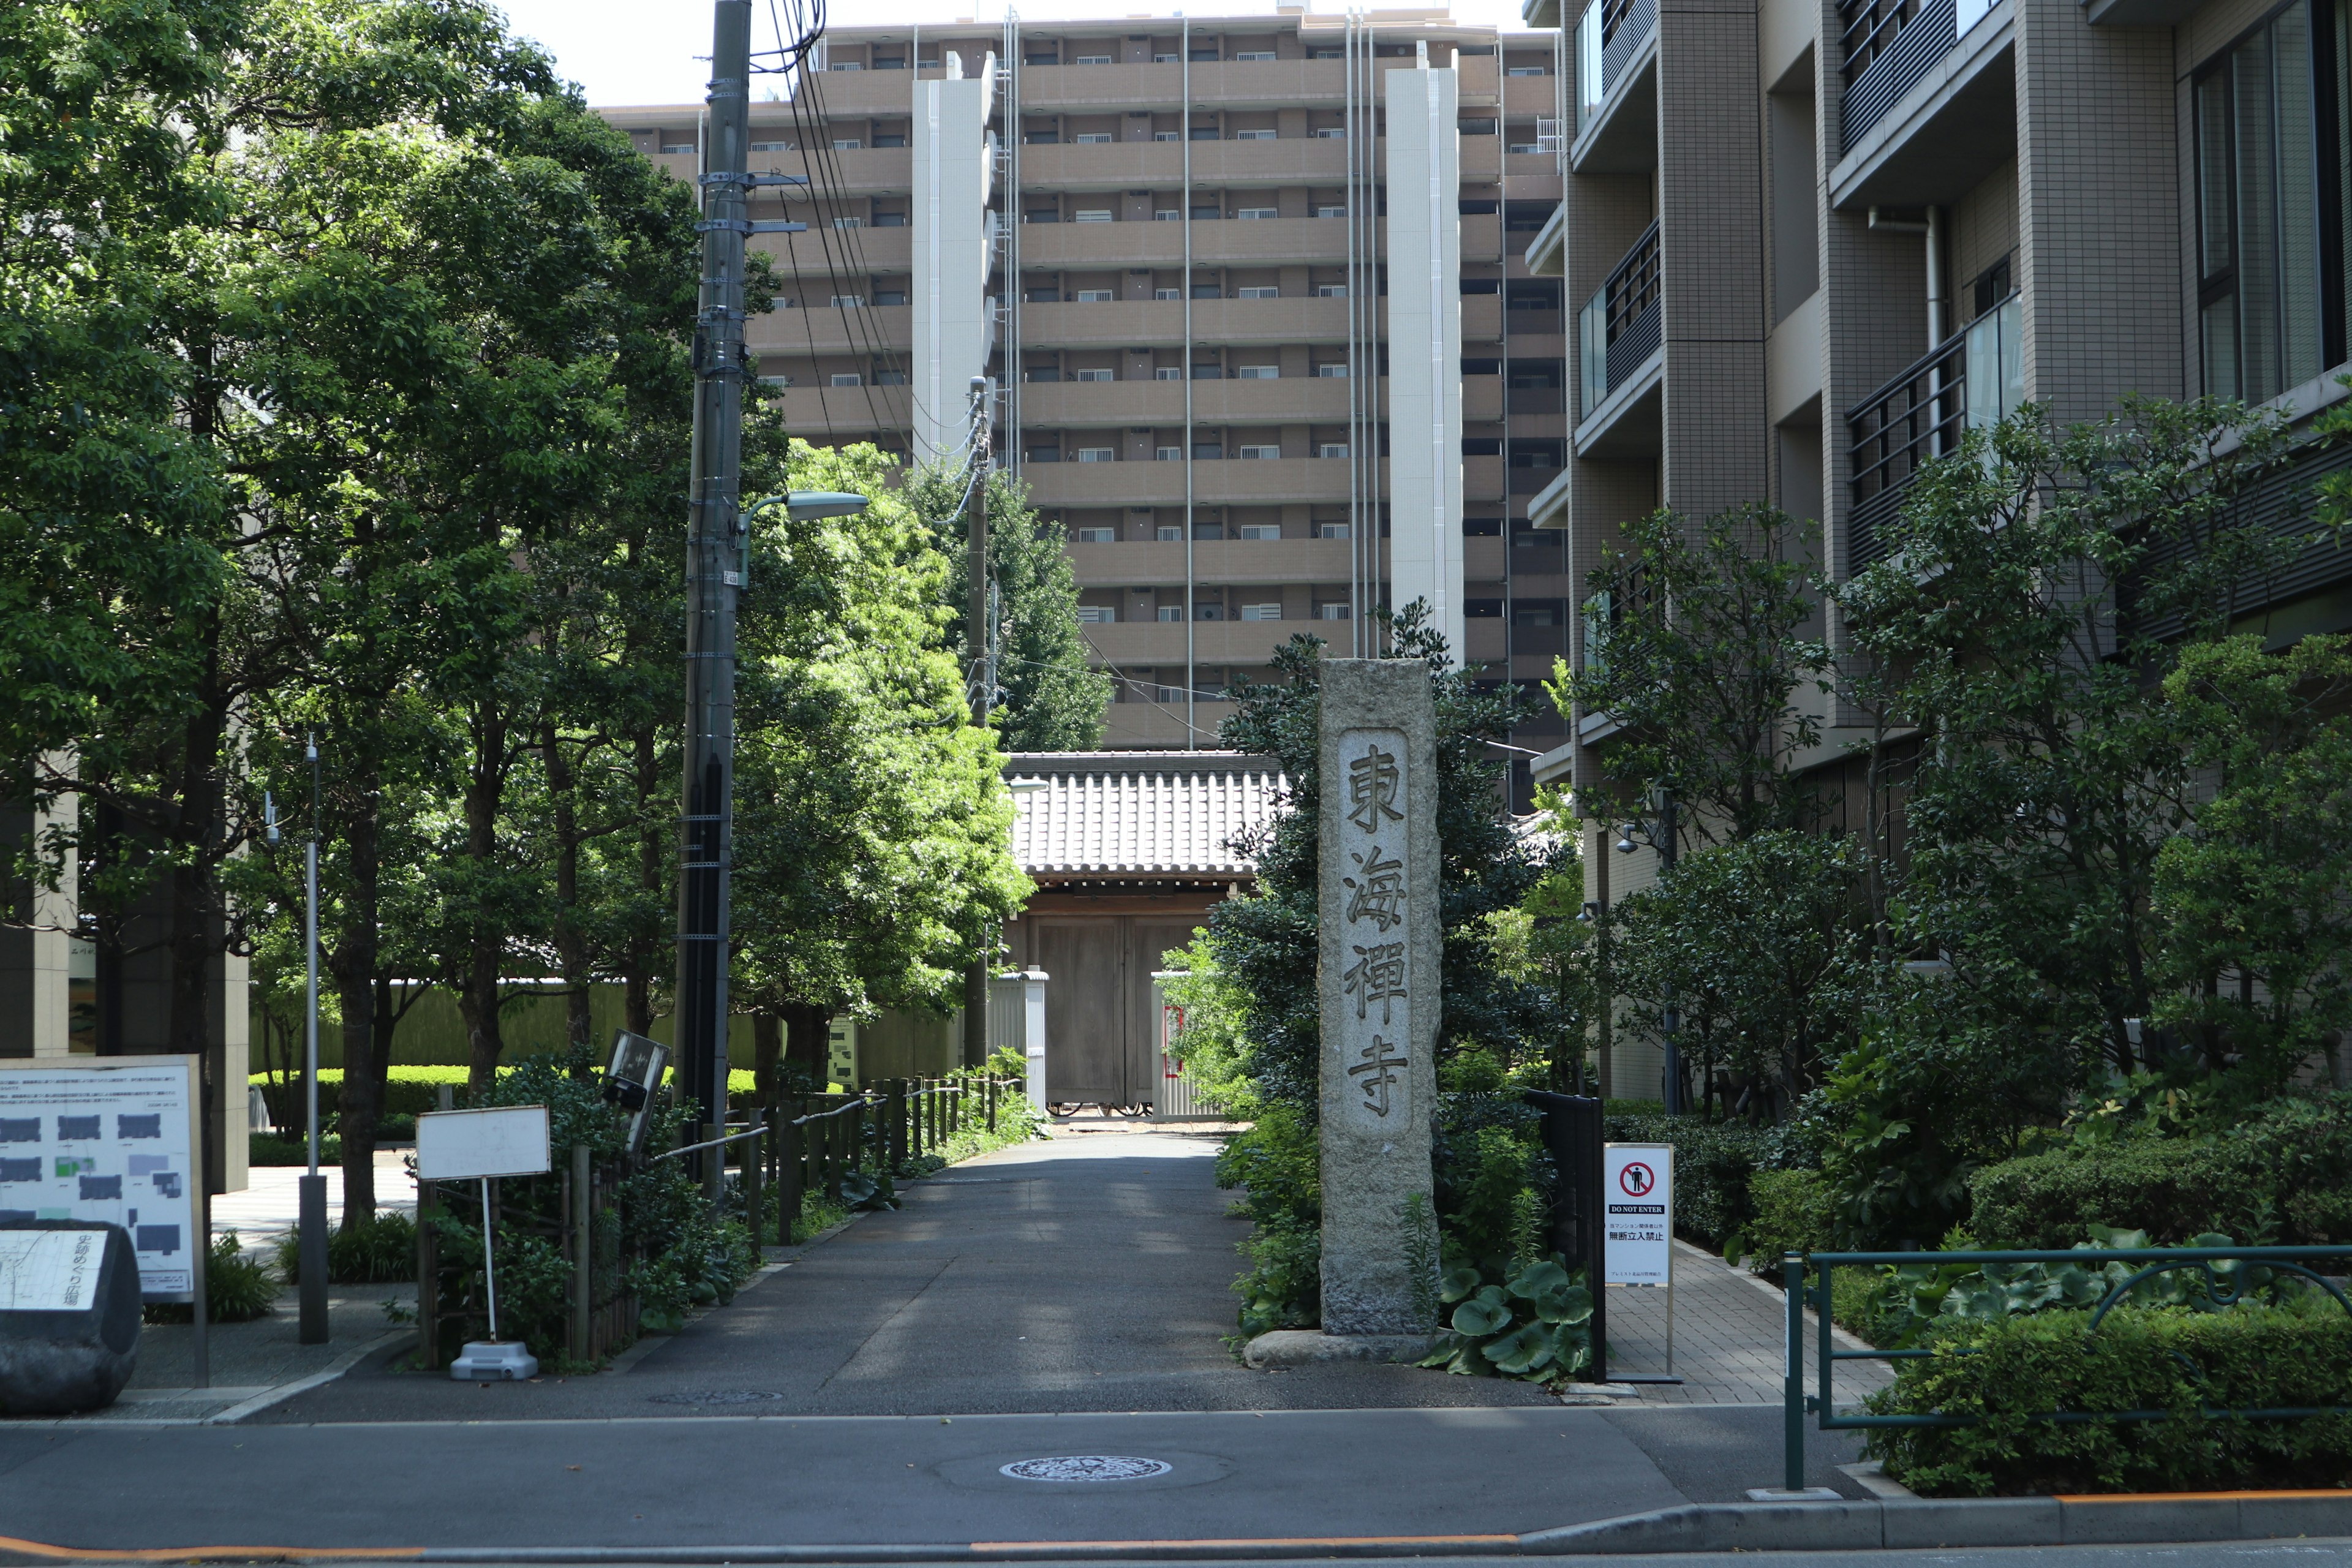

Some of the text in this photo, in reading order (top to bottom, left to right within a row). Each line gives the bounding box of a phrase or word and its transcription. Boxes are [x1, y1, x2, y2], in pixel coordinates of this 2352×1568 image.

[1609, 1231, 1664, 1241] 無断立入禁止
[63, 1234, 92, 1306] 史跡めぐり広場
